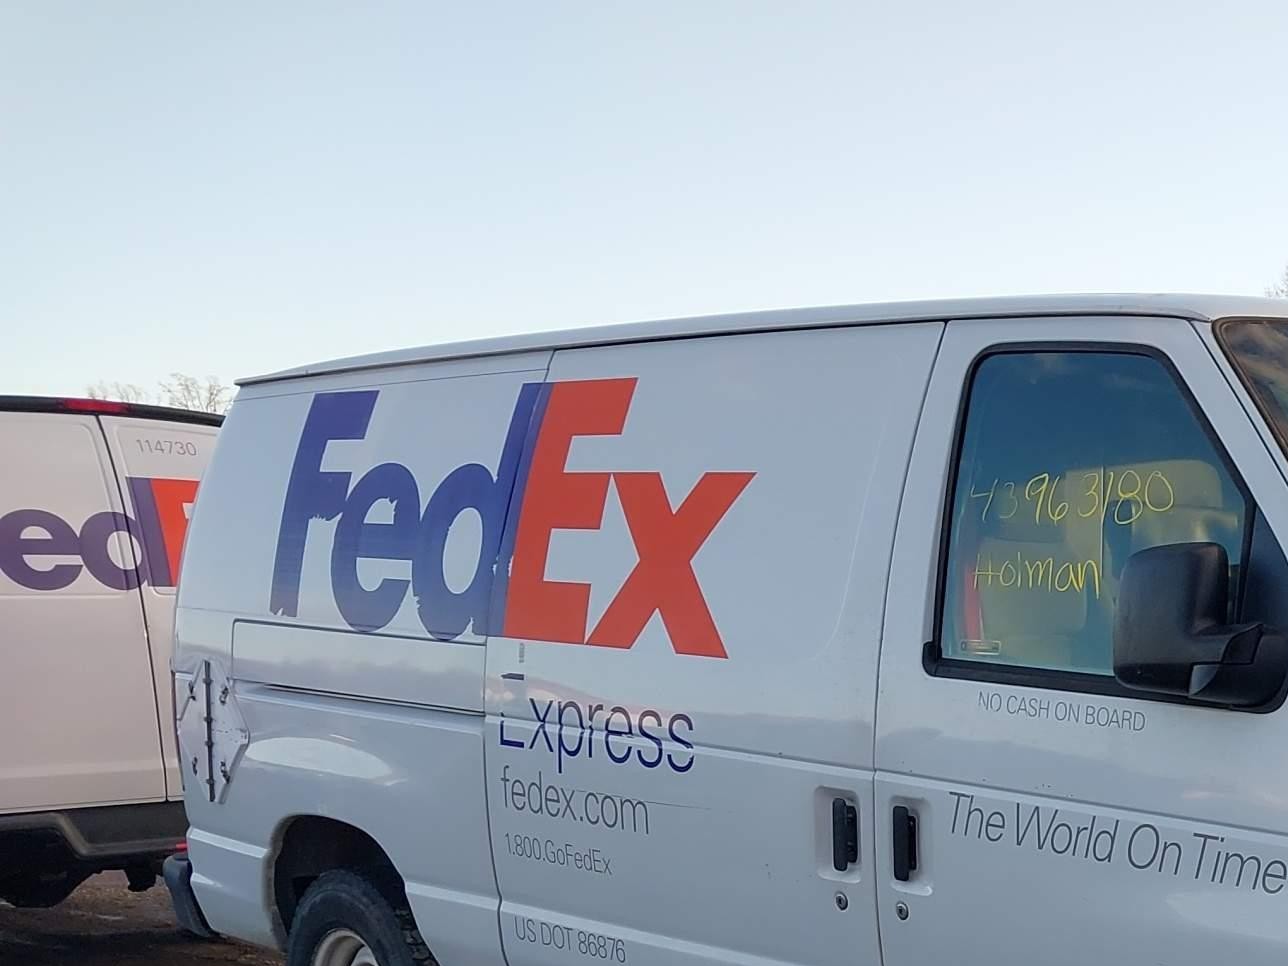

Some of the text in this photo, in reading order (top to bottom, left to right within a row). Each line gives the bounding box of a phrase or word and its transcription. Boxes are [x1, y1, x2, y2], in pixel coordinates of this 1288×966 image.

[136, 439, 197, 457] 114730
[270, 377, 758, 659] FedEx
[970, 469, 1175, 526] 43963180
[972, 551, 1101, 600] Holman
[500, 673, 695, 774] Express
[977, 691, 1147, 732] NO CASH ON BOARD
[501, 765, 649, 835] fedex.com
[504, 832, 613, 876] 1.800.GoFedEx
[949, 791, 1288, 894] The World On Time
[514, 914, 537, 943] US
[540, 921, 574, 951] DOT
